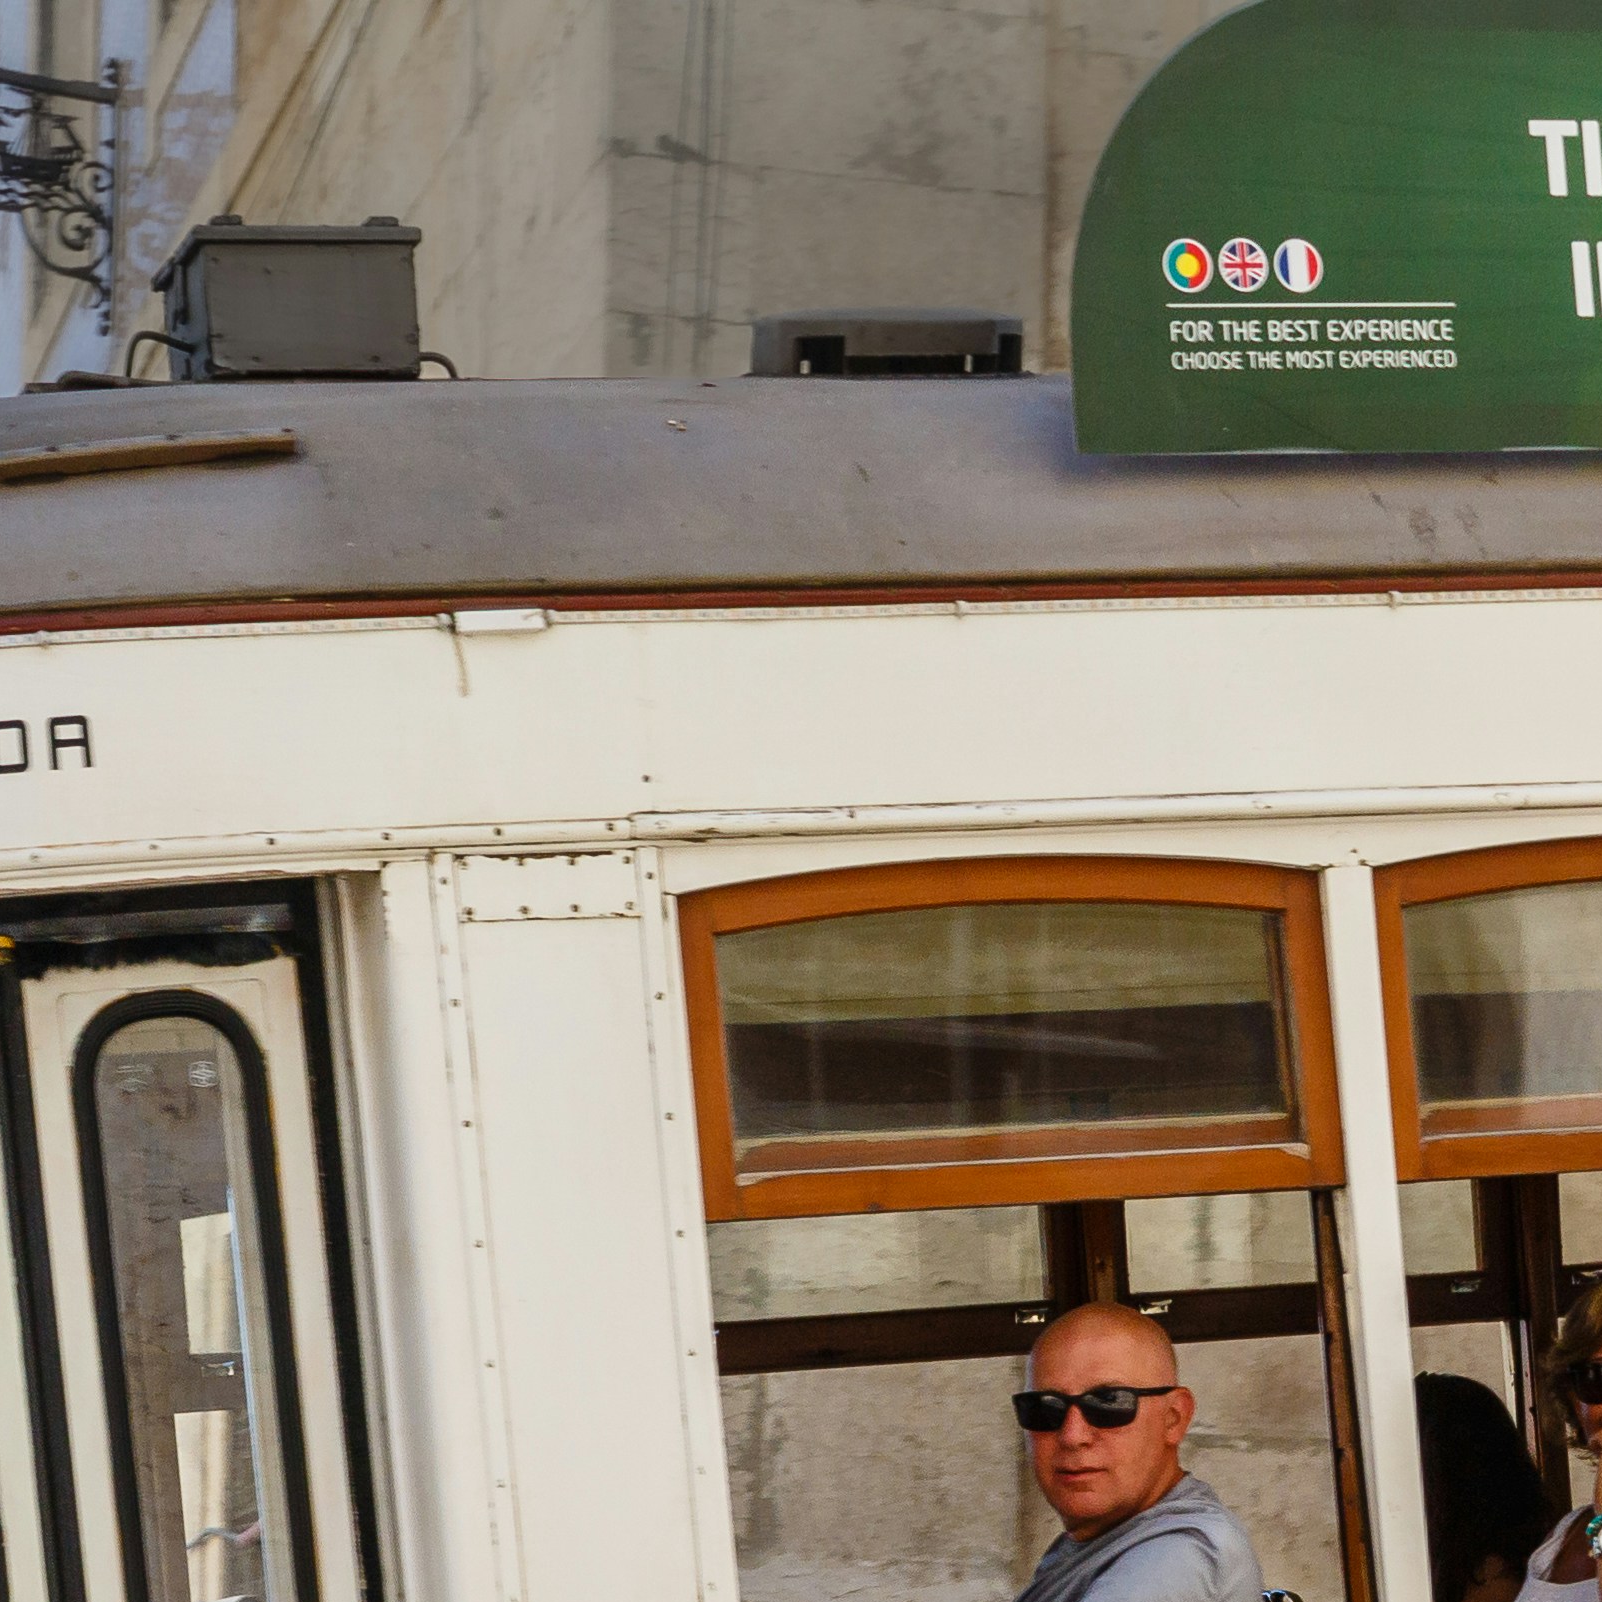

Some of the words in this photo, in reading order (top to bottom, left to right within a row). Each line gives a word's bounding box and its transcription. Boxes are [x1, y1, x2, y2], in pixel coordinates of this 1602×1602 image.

[1169, 319, 1214, 343] FOR
[1217, 319, 1263, 343] THE
[1267, 319, 1320, 342] BEST
[1326, 319, 1456, 342] EXPERIENCE
[1171, 351, 1244, 371] CHOOSE
[1246, 351, 1284, 370] THE
[1285, 350, 1334, 370] MOST
[1338, 349, 1458, 369] EXPERIENCED
